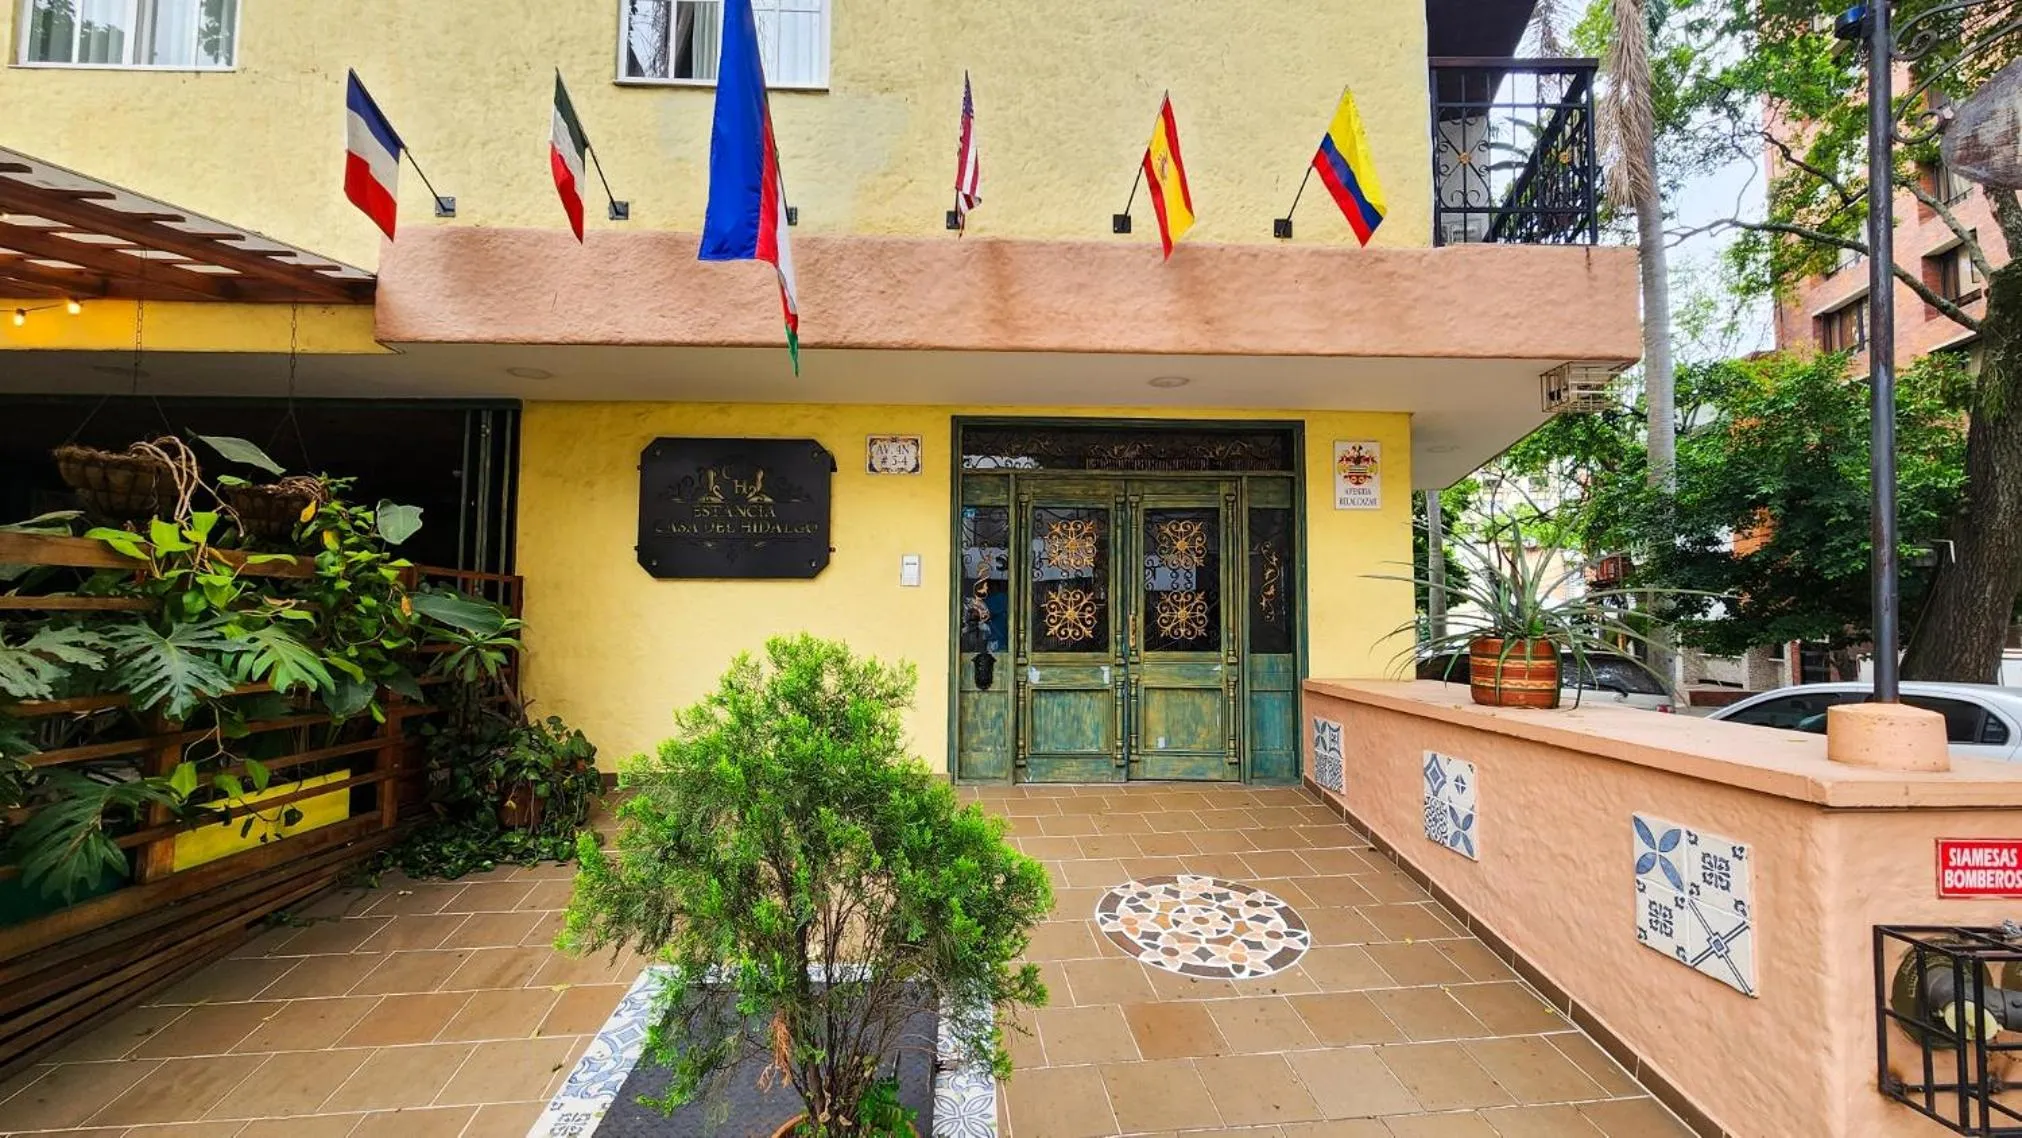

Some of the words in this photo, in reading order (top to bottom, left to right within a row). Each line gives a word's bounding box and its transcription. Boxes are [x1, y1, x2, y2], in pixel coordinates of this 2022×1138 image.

[692, 504, 776, 518] ESTANCIA
[655, 520, 698, 533] CASA
[703, 520, 735, 533] DEL
[739, 521, 819, 534] HIDALGO
[1949, 847, 2018, 867] SIAMESAS
[1944, 869, 2022, 889] BOMBEROS
